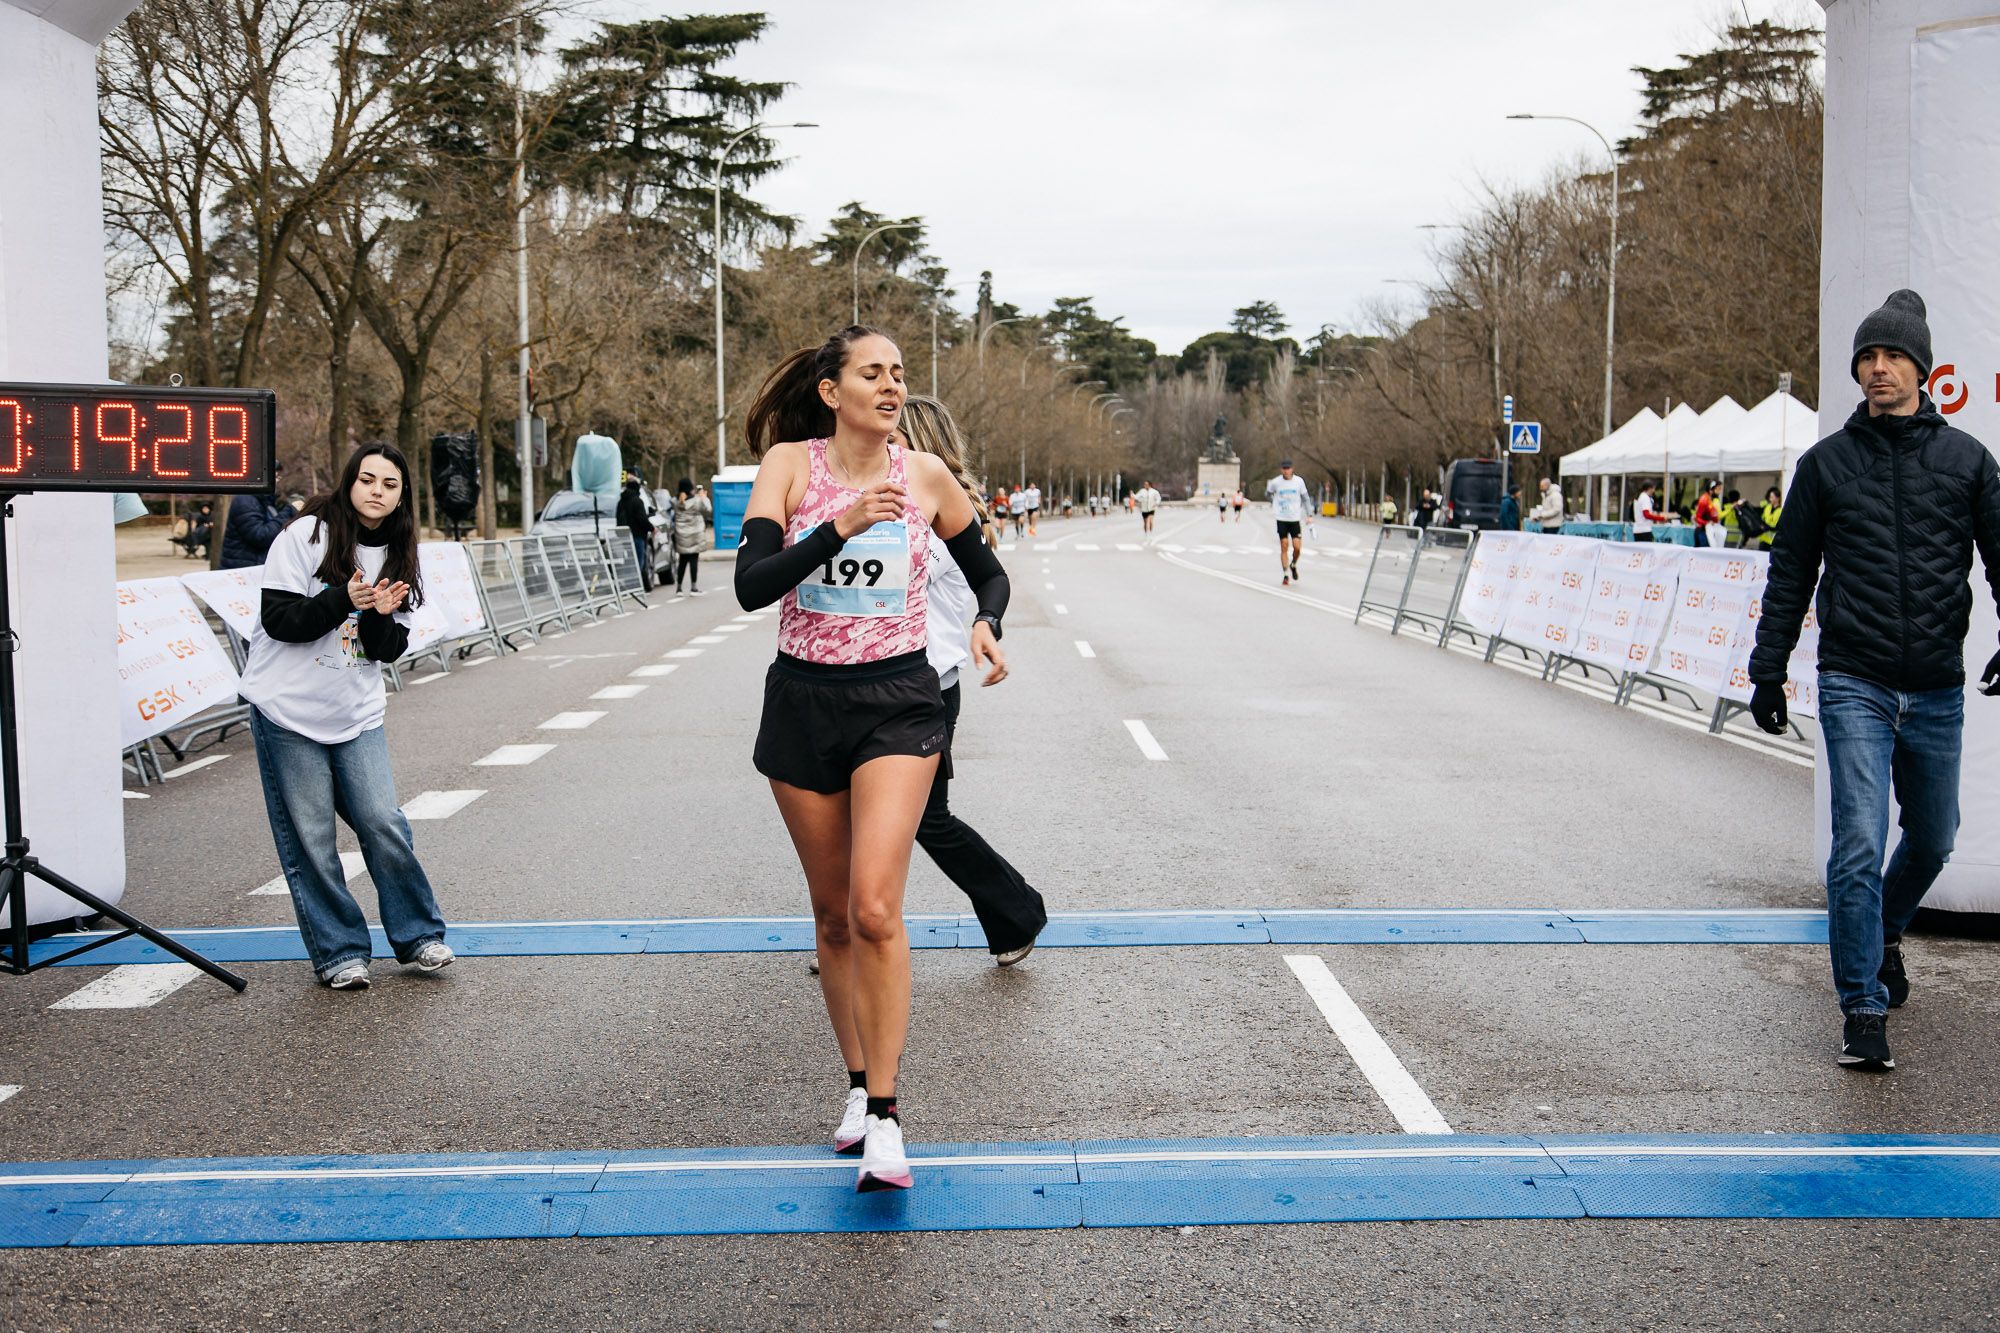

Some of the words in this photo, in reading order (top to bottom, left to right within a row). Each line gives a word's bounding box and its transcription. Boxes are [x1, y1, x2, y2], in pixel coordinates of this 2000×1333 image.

[821, 557, 884, 587] 199
[1562, 571, 1583, 590] GSK
[1724, 560, 1747, 581] GSK
[1644, 583, 1667, 602] GSK
[1686, 589, 1707, 609] GSK
[875, 601, 886, 609] CSL
[1545, 623, 1568, 644] GSK
[1707, 626, 1730, 647] GSK
[167, 638, 204, 660] GSK
[1670, 651, 1688, 675] GSK
[137, 684, 185, 721] GSK
